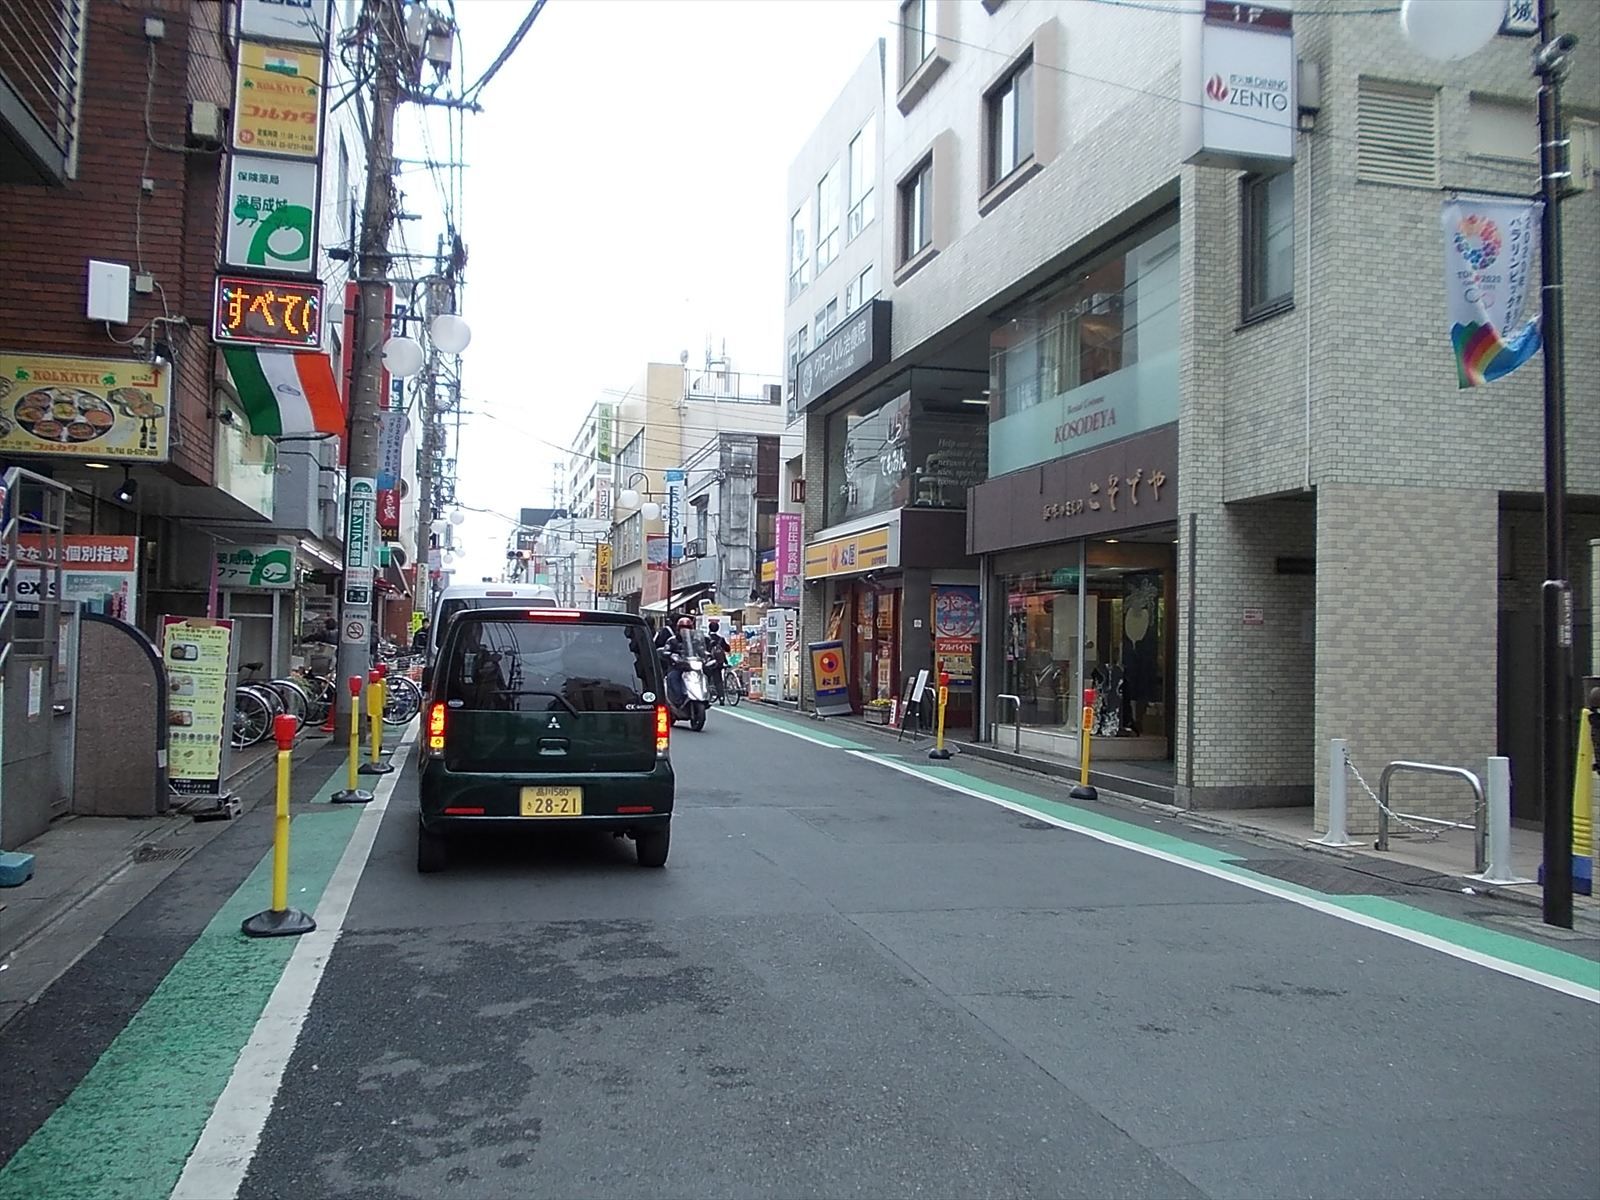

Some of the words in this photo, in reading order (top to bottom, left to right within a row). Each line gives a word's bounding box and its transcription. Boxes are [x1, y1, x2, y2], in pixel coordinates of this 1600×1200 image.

[1230, 87, 1288, 111] ZENTO
[240, 104, 317, 124] コルカタ
[237, 171, 280, 185] 保険薬局
[236, 194, 288, 214] 薬局成城
[32, 370, 100, 385] KOLKATA
[1053, 407, 1117, 444] KOSODEYA
[1088, 468, 1167, 512] こそでや
[670, 485, 680, 539] EPSON
[841, 543, 856, 566] 松屋
[822, 677, 841, 686] 松屋
[535, 797, 577, 813] 28-21
